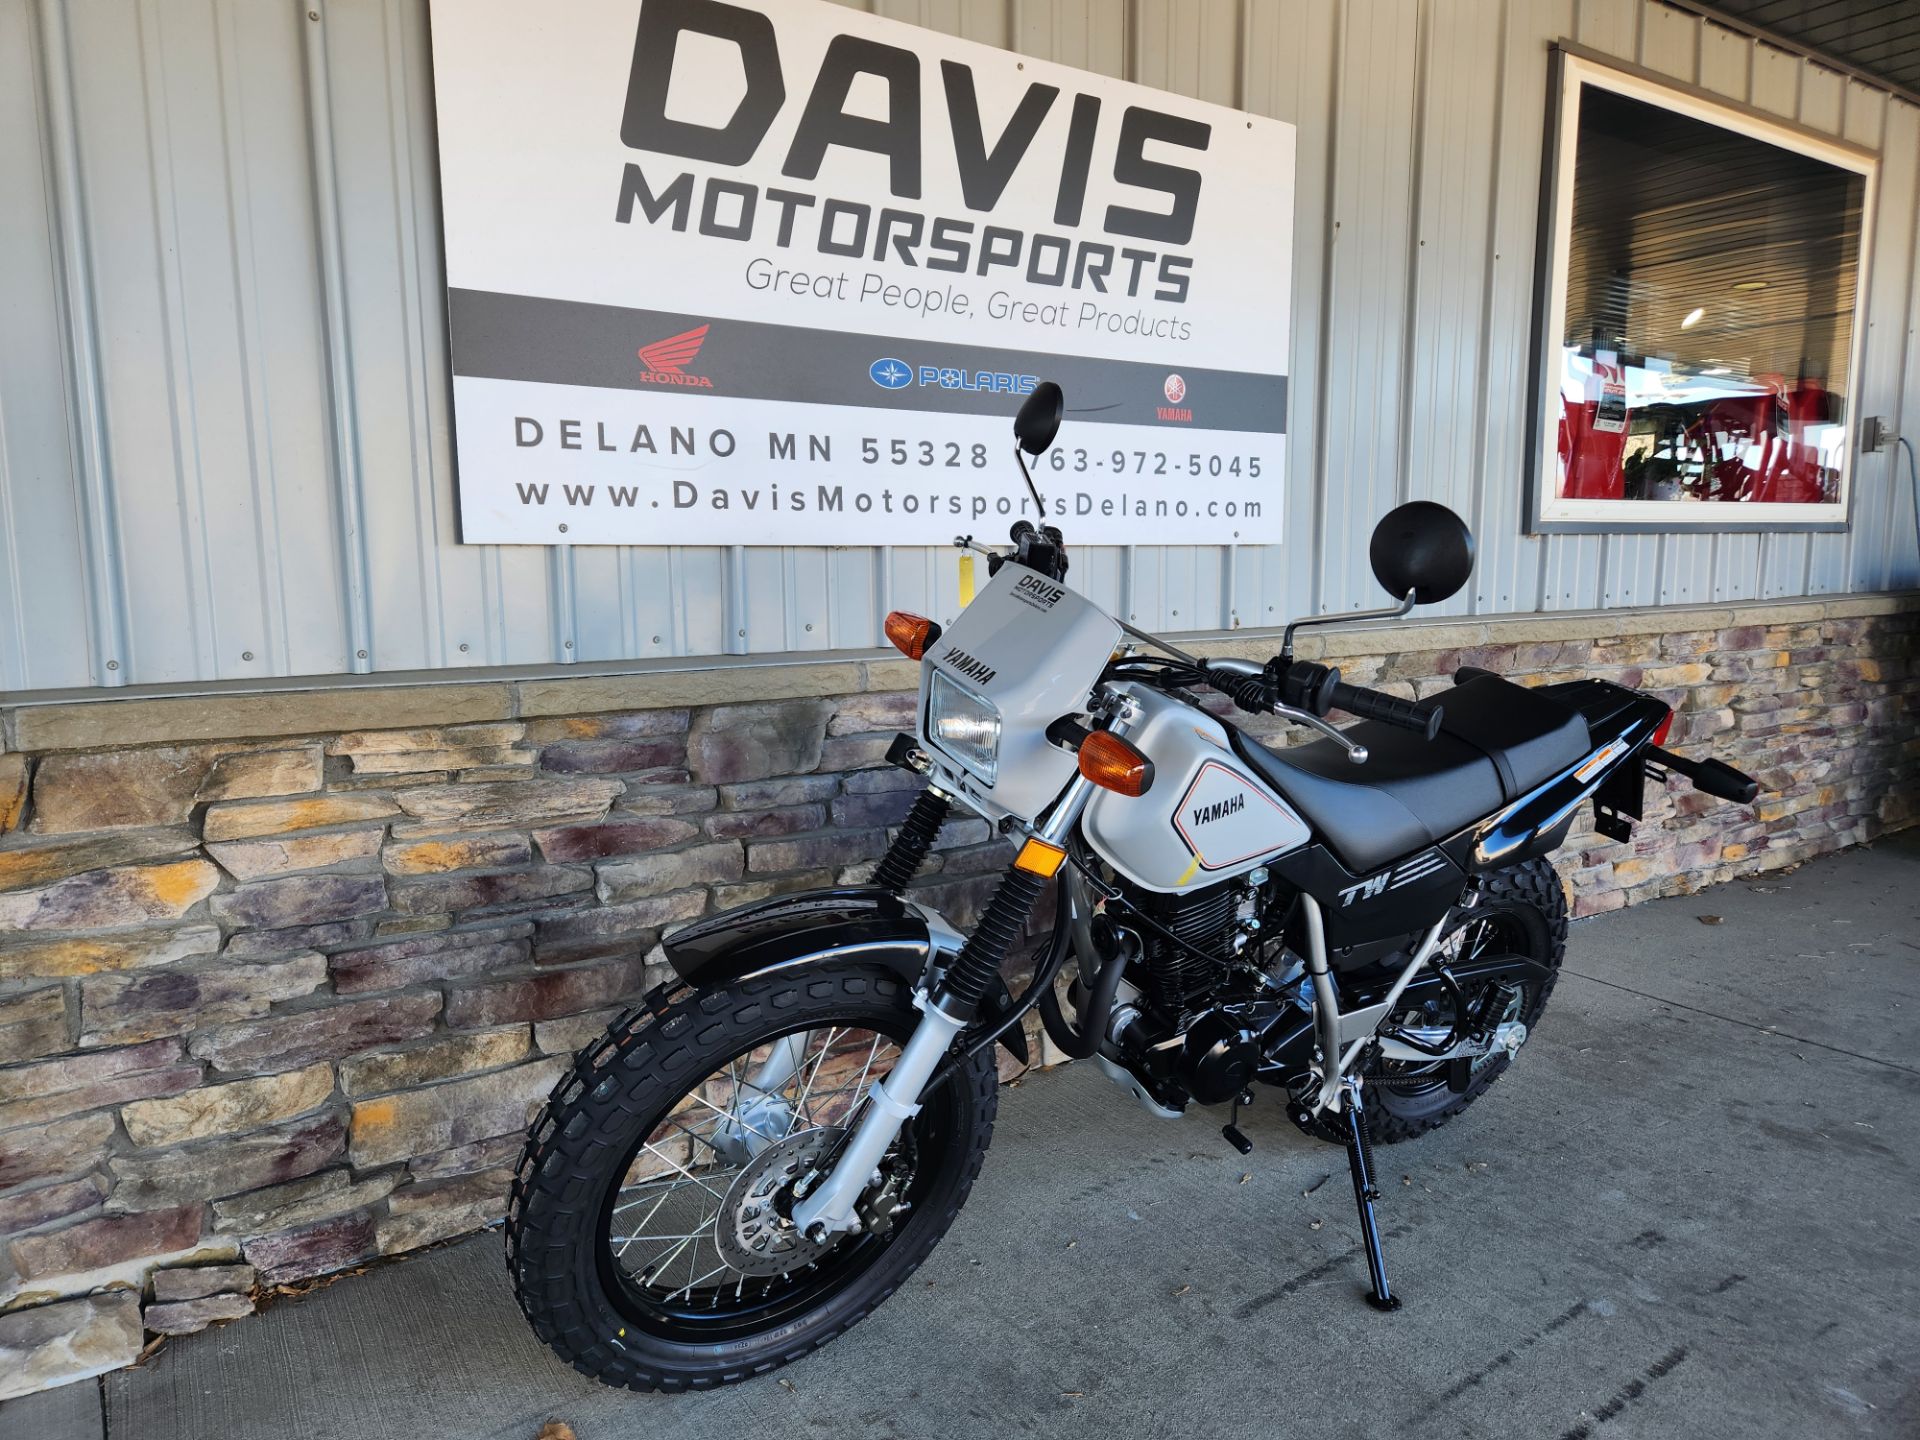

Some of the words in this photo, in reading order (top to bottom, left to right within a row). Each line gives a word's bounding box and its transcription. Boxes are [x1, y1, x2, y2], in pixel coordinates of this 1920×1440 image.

[620, 0, 1212, 246] DAVIS
[615, 162, 1194, 304] MOTORSPORTS
[746, 257, 849, 301] Great
[860, 273, 975, 320] People,
[987, 291, 1070, 328] Great
[1077, 302, 1193, 342] Products
[640, 371, 714, 388] HONDA
[919, 365, 1039, 396] POLARIS
[1156, 407, 1193, 423] YAMAHA
[514, 416, 736, 458] DELANO
[769, 432, 832, 462] MN
[861, 437, 988, 468] 55328
[1018, 574, 1066, 604] DAVIS
[943, 646, 997, 686] YAMAHA
[1193, 792, 1245, 826] YAMAHA
[1338, 871, 1392, 908] TW
